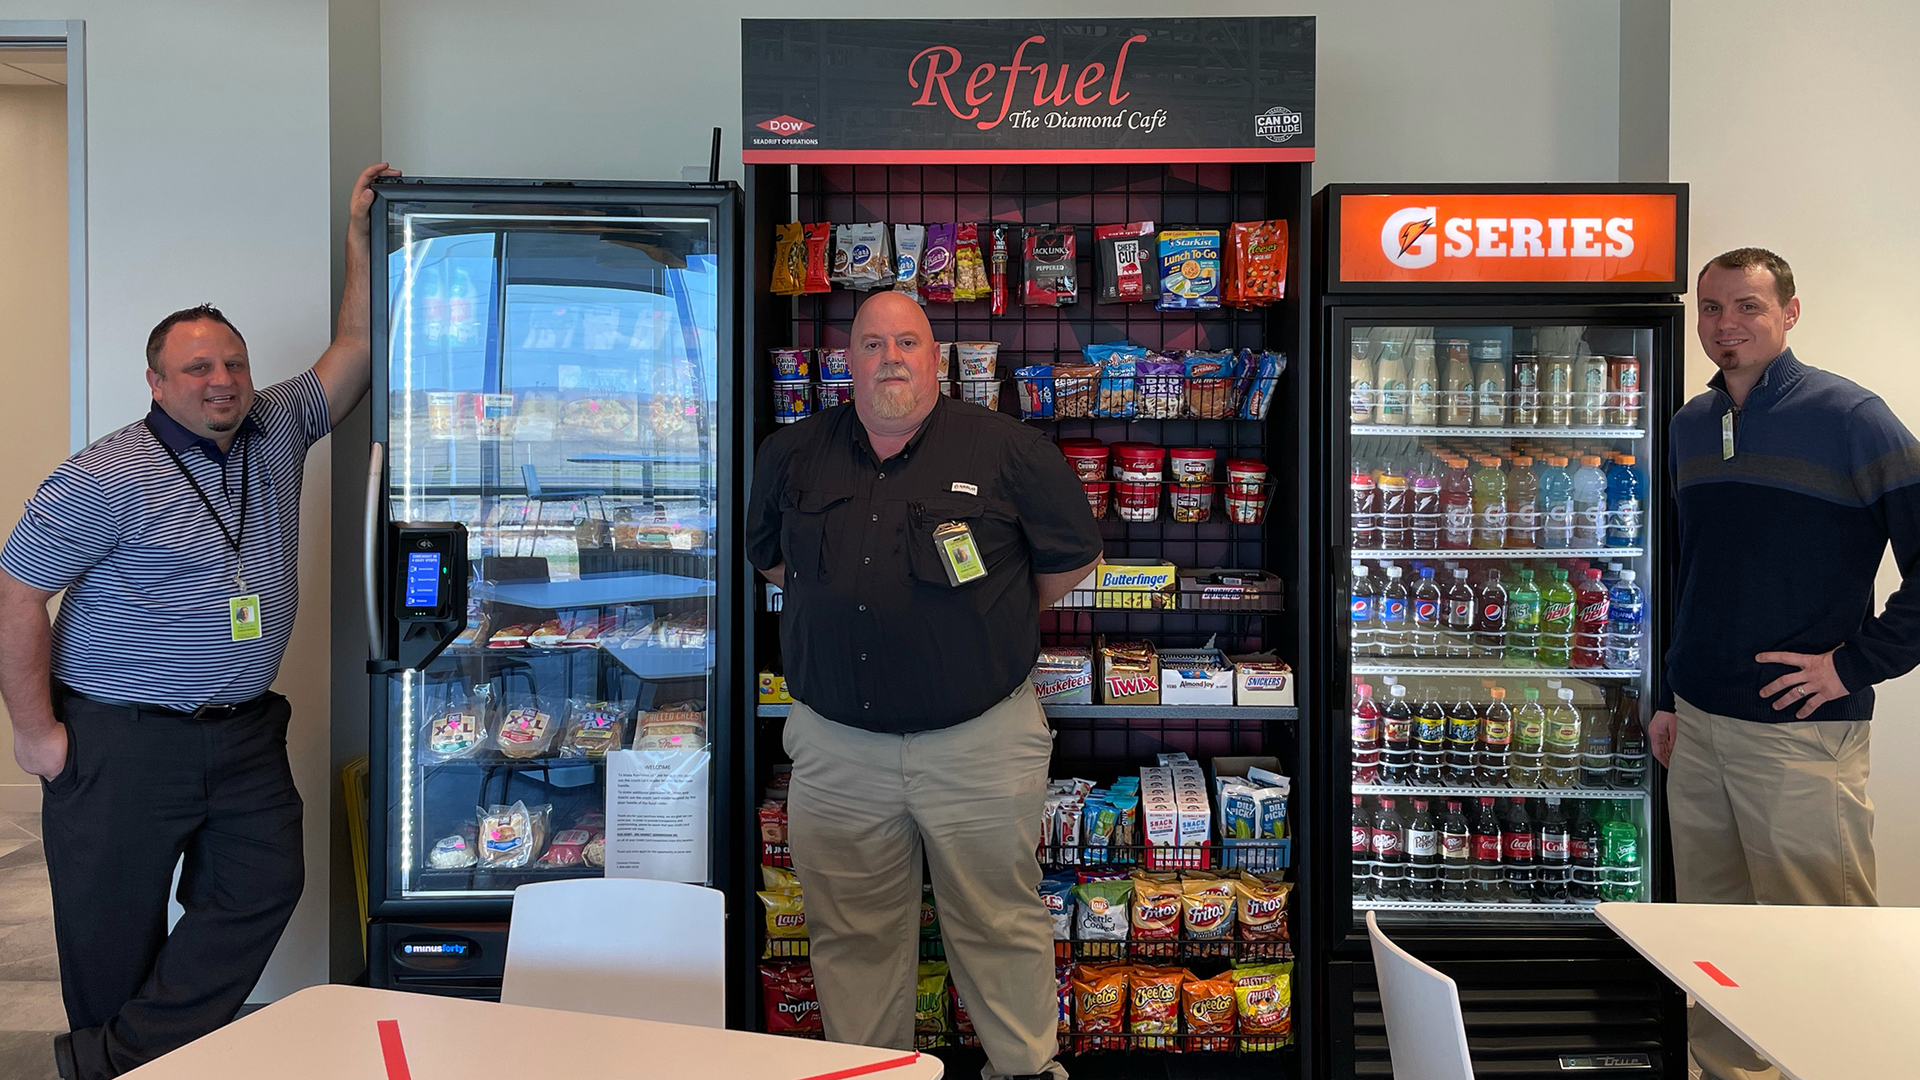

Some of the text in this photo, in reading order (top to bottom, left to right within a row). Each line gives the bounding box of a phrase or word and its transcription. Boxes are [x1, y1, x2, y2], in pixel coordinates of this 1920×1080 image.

[907, 34, 1148, 131] Refuel
[1009, 110, 1167, 133] The Diamond Café
[1257, 115, 1300, 126] CAN DO
[1258, 124, 1300, 134] ATTITUDE
[1175, 238, 1212, 246] StarKist
[1381, 206, 1634, 270] G SERIES
[1032, 248, 1048, 256] JACK
[1118, 243, 1137, 251] CHEF'S
[1118, 252, 1137, 264] CUT
[1164, 250, 1190, 266] Lunch
[962, 356, 988, 364] Cinnamon
[964, 367, 988, 376] Crunch
[1140, 384, 1182, 394] TEXAS
[1102, 573, 1168, 587] Butterfinger
[1034, 673, 1092, 696] Musketeers
[1247, 677, 1281, 686] SNICKERS
[645, 712, 674, 722] GRILLED
[1269, 803, 1286, 812] DILL
[1265, 809, 1286, 822] PICK
[1150, 819, 1173, 827] SNACK
[1182, 820, 1206, 828] SNACK
[1141, 904, 1177, 920] Fritos
[1248, 898, 1280, 915] Fritos
[1086, 912, 1112, 922] Kettle
[1188, 904, 1225, 923] Fritos
[778, 914, 804, 926] Lay's
[1084, 920, 1115, 932] Cooked
[413, 944, 465, 954] minusforty
[1082, 988, 1117, 1012] Cheetos
[1135, 984, 1175, 1006] Cheetos
[778, 1000, 819, 1013] Dorito
[1193, 996, 1232, 1016] Cheetos
